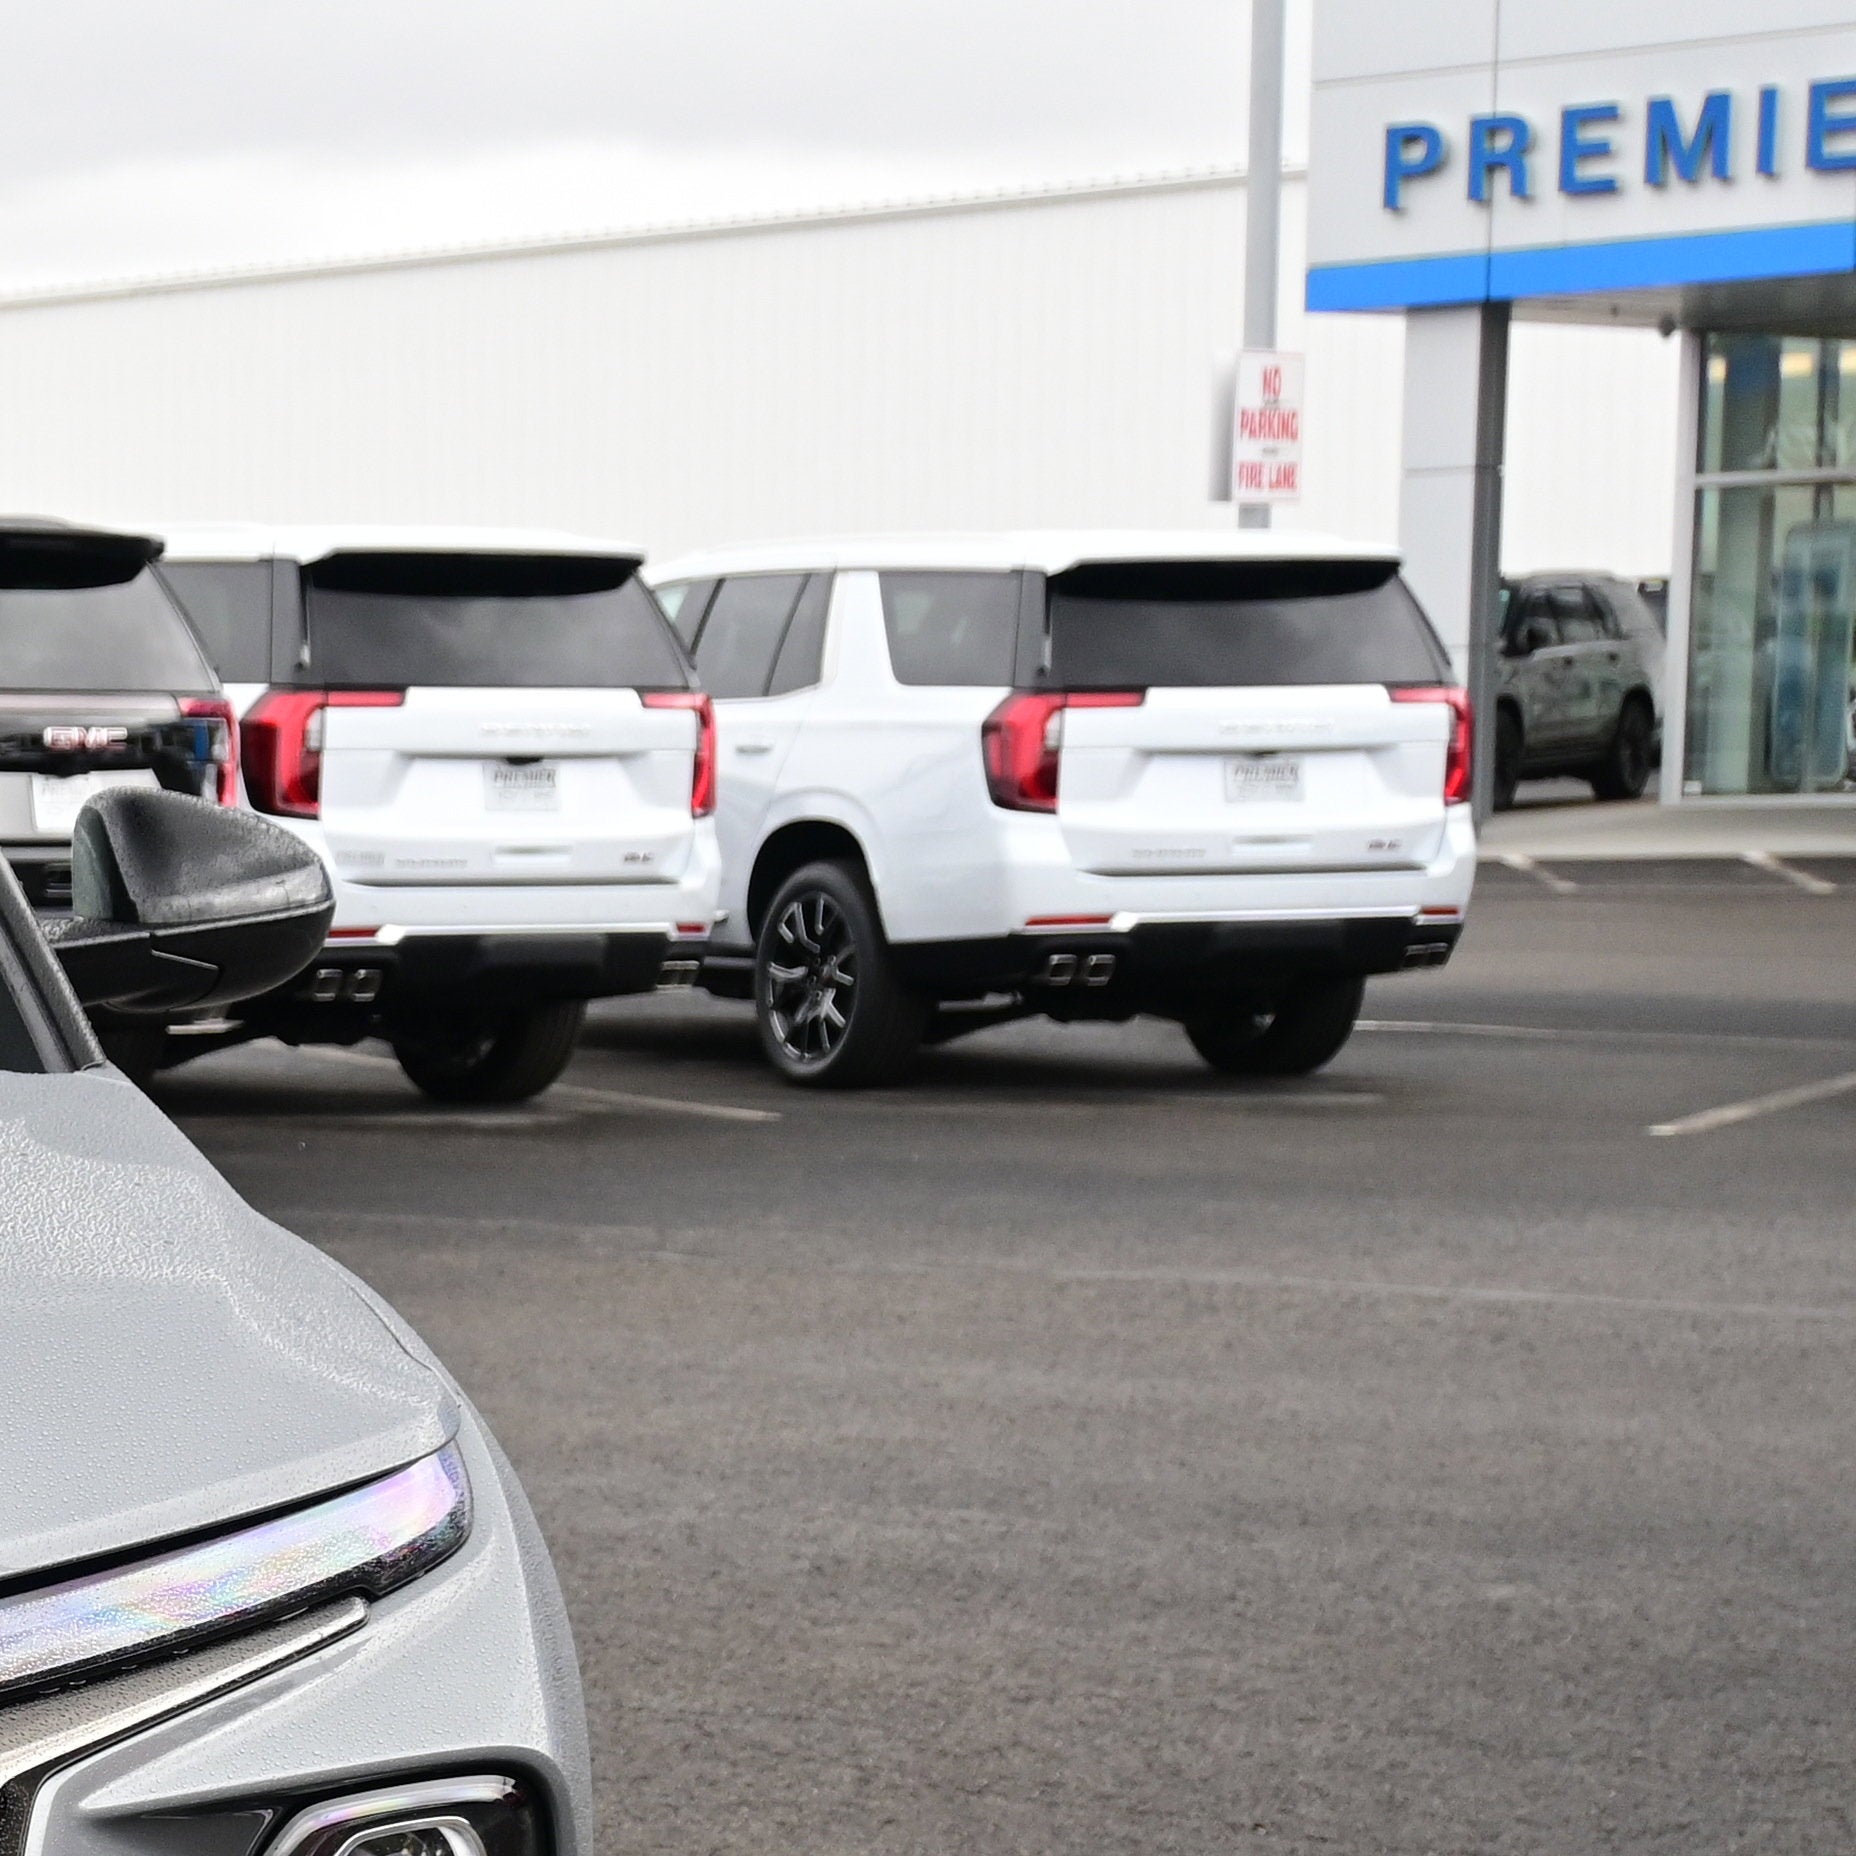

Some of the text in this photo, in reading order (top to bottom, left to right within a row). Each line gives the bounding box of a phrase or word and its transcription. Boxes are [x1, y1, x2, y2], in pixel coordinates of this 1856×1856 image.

[1383, 76, 1856, 211] PREMIE
[1262, 366, 1282, 398] NO
[1240, 407, 1299, 441] PARKING
[1238, 461, 1297, 490] FIRE LANE
[43, 726, 128, 751] GMC
